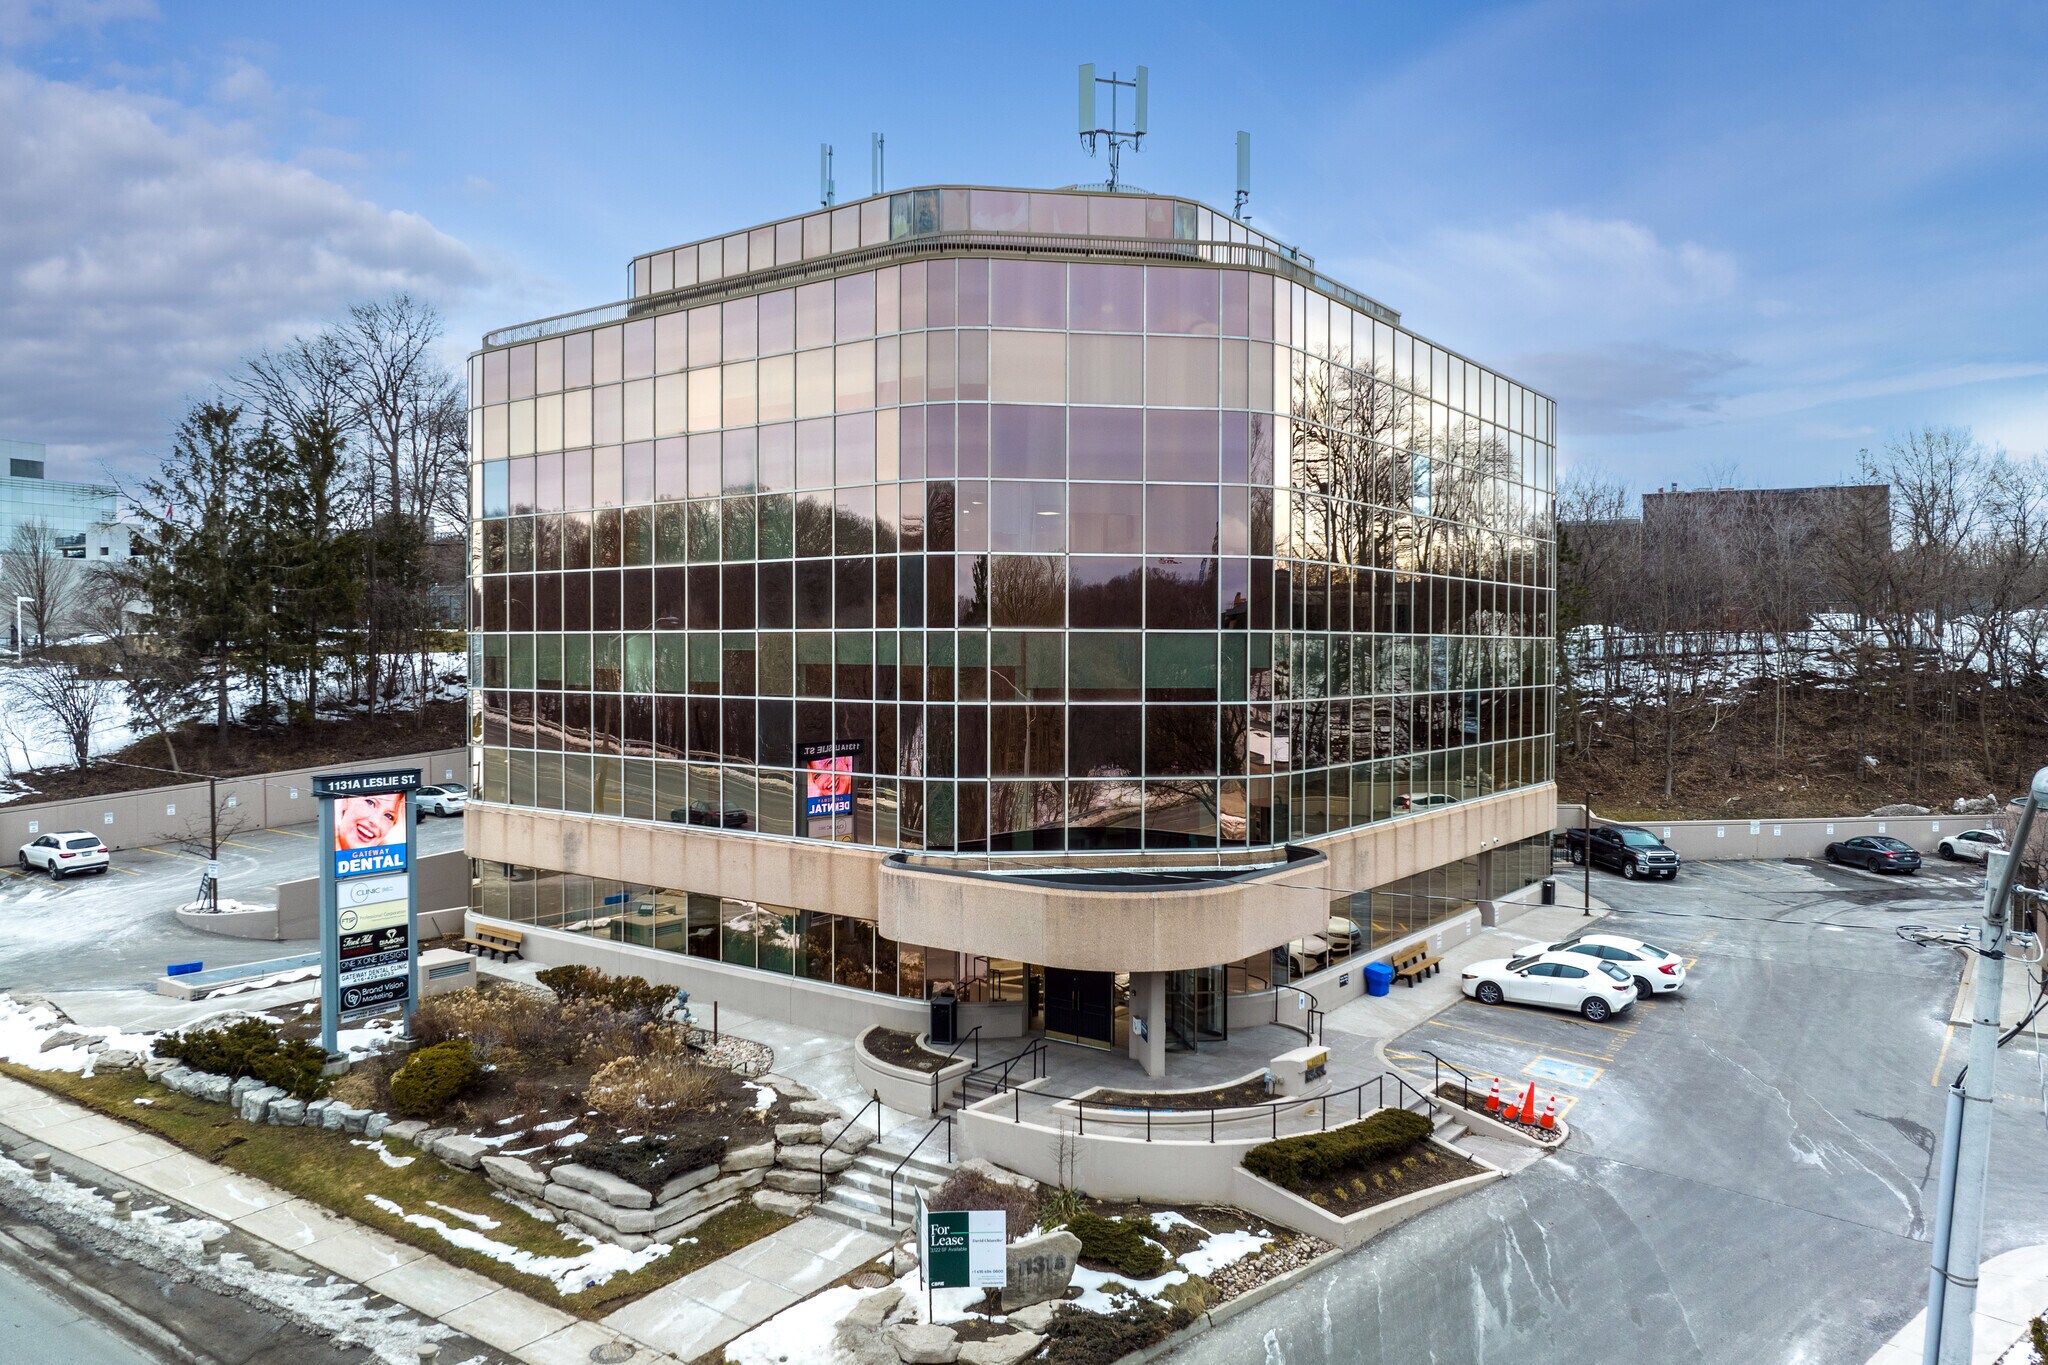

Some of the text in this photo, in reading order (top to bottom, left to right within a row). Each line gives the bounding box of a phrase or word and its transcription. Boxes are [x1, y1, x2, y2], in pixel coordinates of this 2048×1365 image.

[328, 774, 416, 791] 1131A LESLIE ST.
[352, 848, 390, 859] GATEWAY
[338, 854, 404, 874] DENTAL
[356, 887, 381, 896] CLINIC
[341, 960, 356, 969] ONE
[363, 955, 378, 964] ONE
[380, 950, 407, 960] DESIGN
[341, 971, 367, 981] GATEWAY
[368, 967, 389, 976] DENTAL
[390, 962, 408, 972] CLINIC
[362, 981, 404, 996] Brand Vision
[362, 991, 394, 1003] Marketing
[930, 1223, 950, 1235] For
[930, 1236, 964, 1247] Lease
